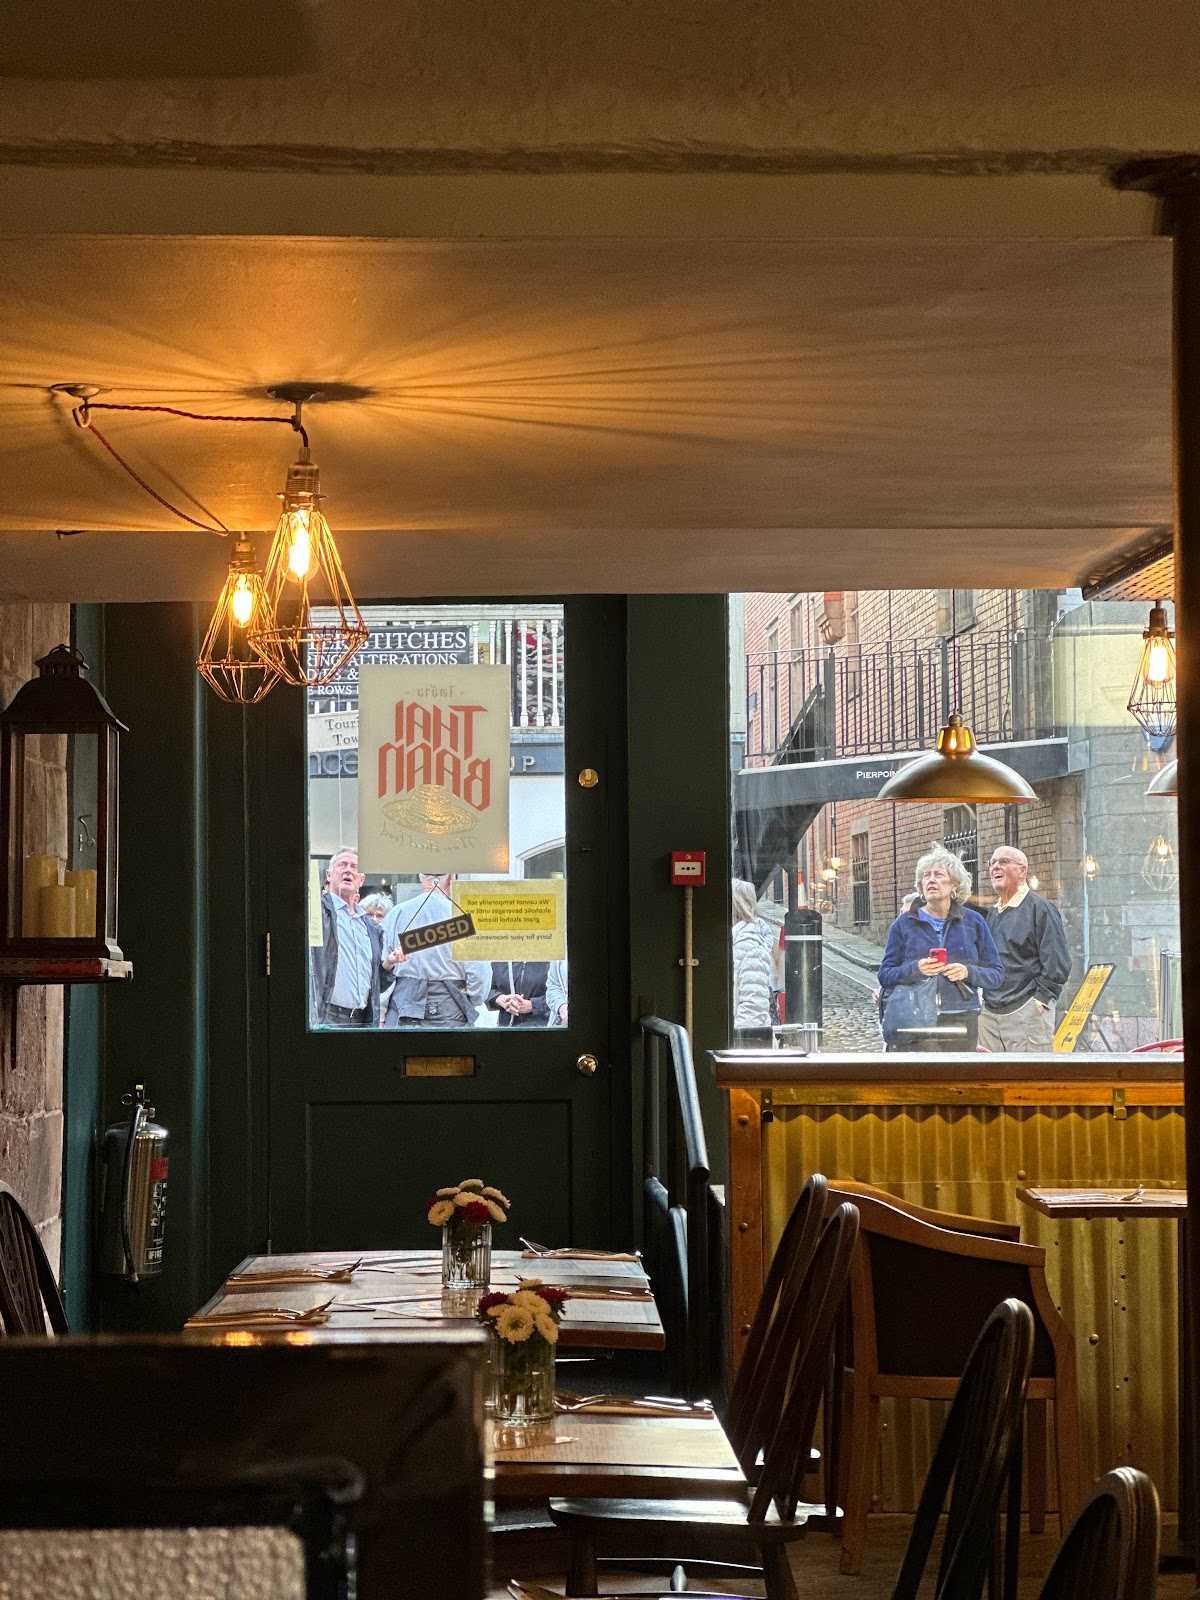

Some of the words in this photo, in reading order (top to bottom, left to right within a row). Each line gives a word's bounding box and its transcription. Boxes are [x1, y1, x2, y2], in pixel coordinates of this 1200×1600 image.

[348, 653, 458, 666] ALTERATIONS
[347, 668, 359, 680] &
[318, 685, 352, 695] ROWS
[404, 919, 469, 948] CLOSED
